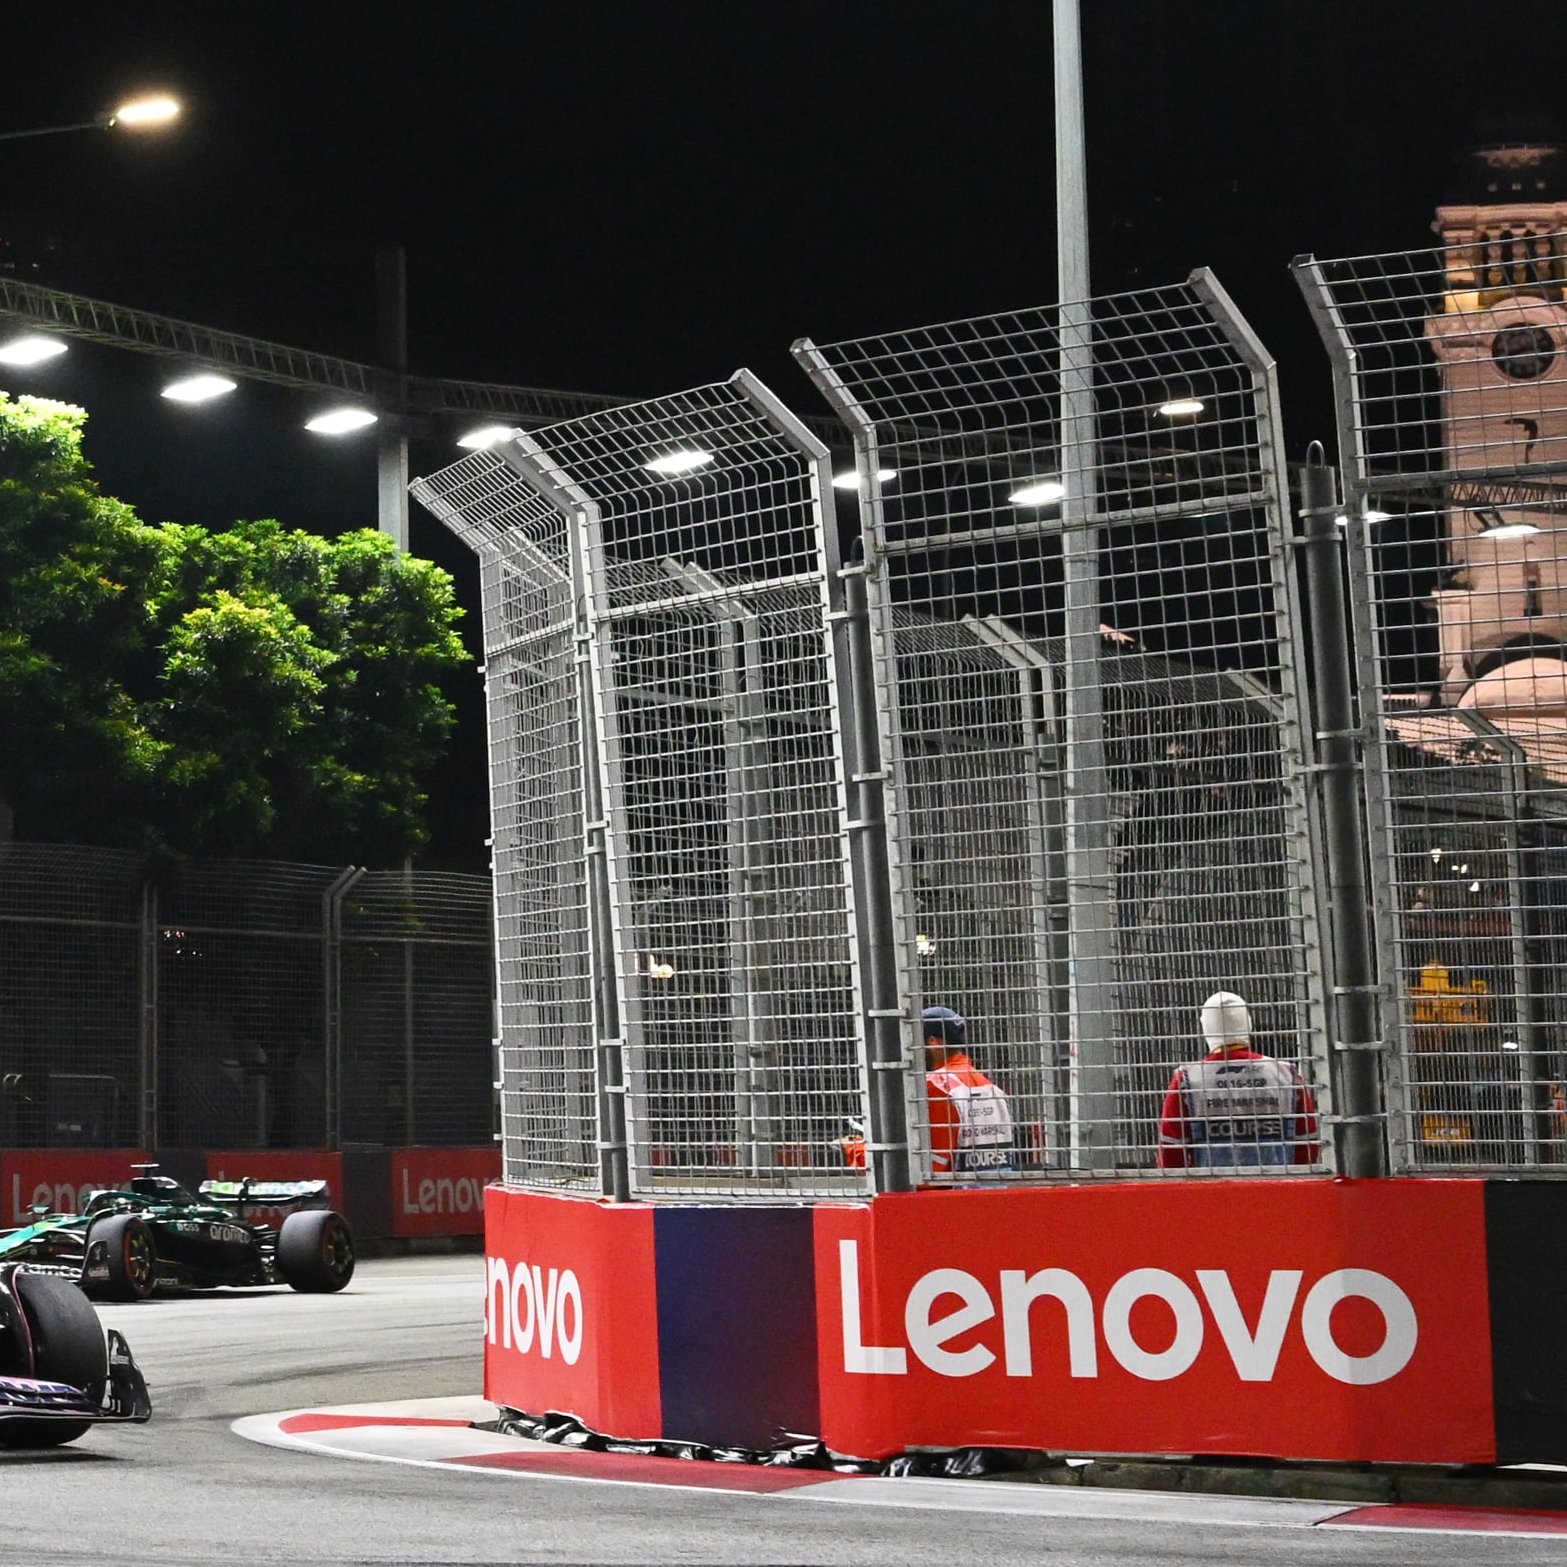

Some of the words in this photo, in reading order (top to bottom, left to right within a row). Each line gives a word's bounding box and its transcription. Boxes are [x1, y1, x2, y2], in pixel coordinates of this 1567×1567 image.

[1209, 1120, 1281, 1137] COURSE
[402, 1168, 503, 1214] Lenov
[484, 1256, 583, 1366] novo
[838, 1239, 1418, 1385] Lenovo
